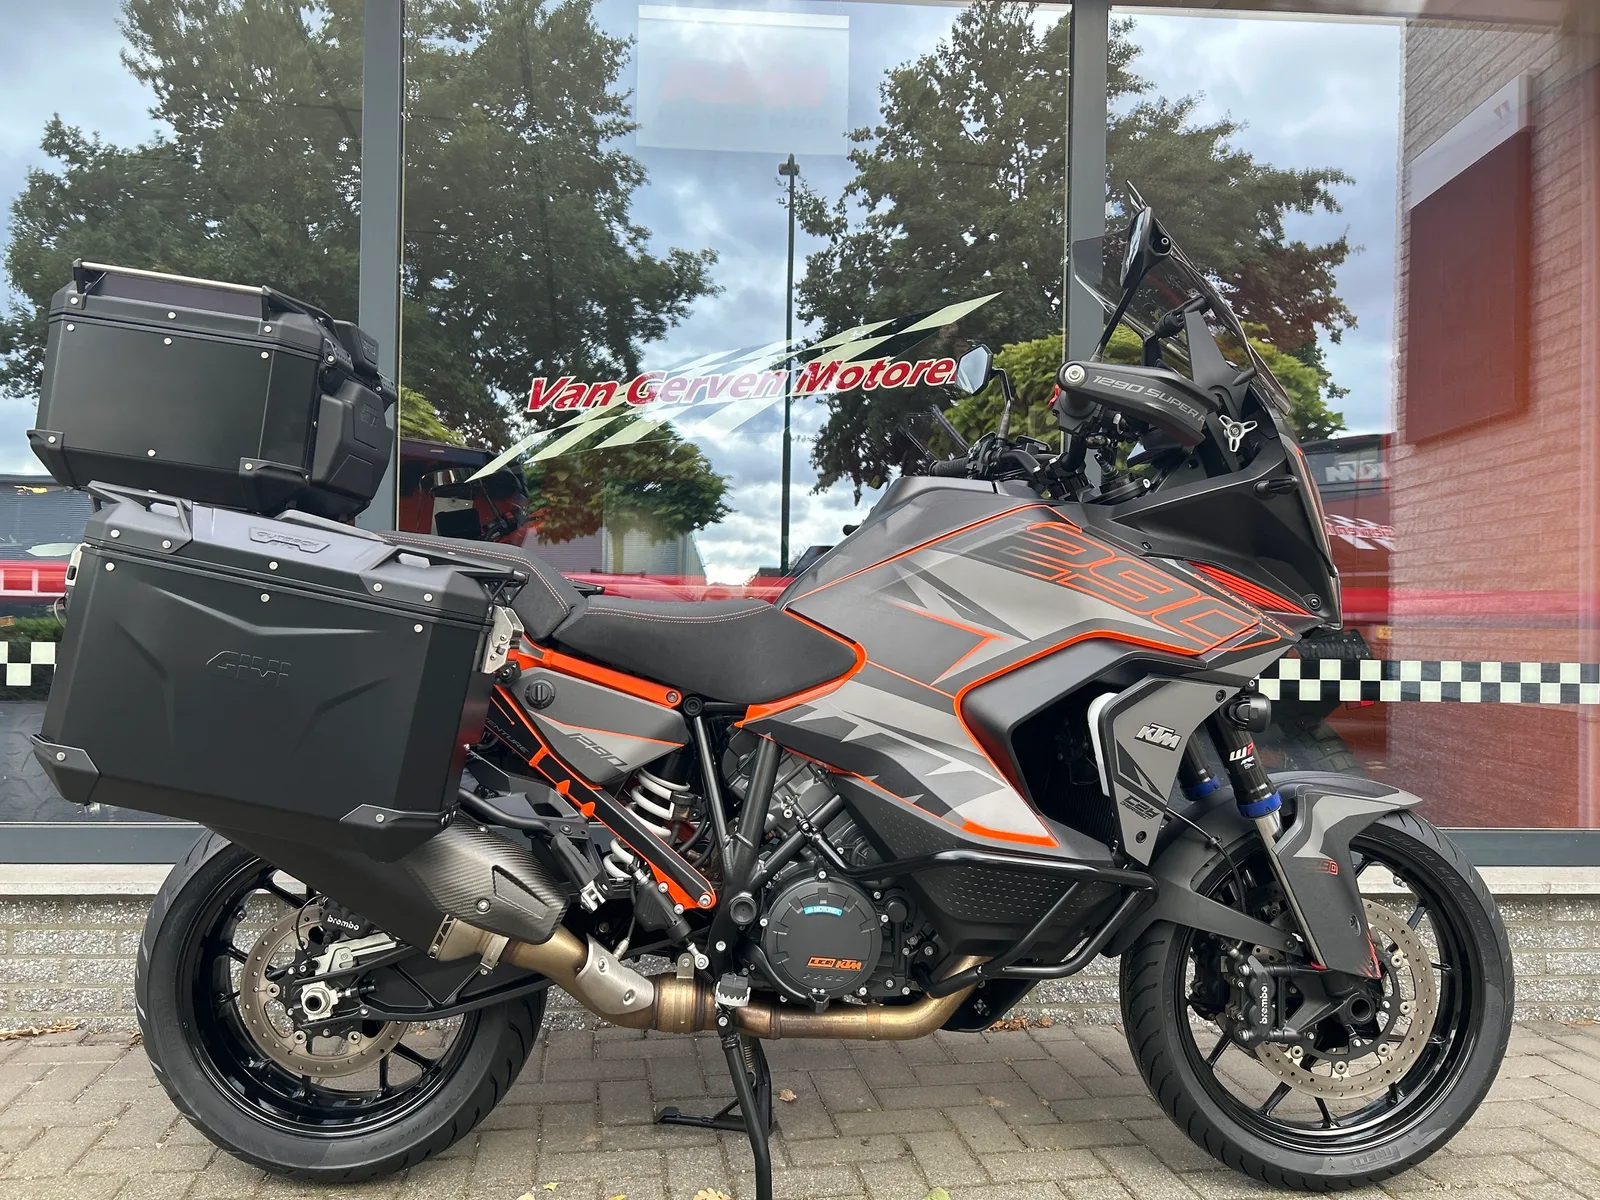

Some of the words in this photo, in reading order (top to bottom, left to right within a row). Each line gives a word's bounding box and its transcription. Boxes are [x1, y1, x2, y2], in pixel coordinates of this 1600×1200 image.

[527, 376, 619, 412] Van
[626, 369, 787, 405] Gerven
[791, 356, 957, 395] Motore
[1092, 375, 1144, 393] 1290
[1144, 388, 1199, 423] SUPER
[486, 718, 530, 754] ENTURE
[1134, 723, 1182, 751] KTM
[327, 914, 360, 931] brembo
[834, 959, 863, 970] KTM
[1259, 985, 1268, 1024] brembo
